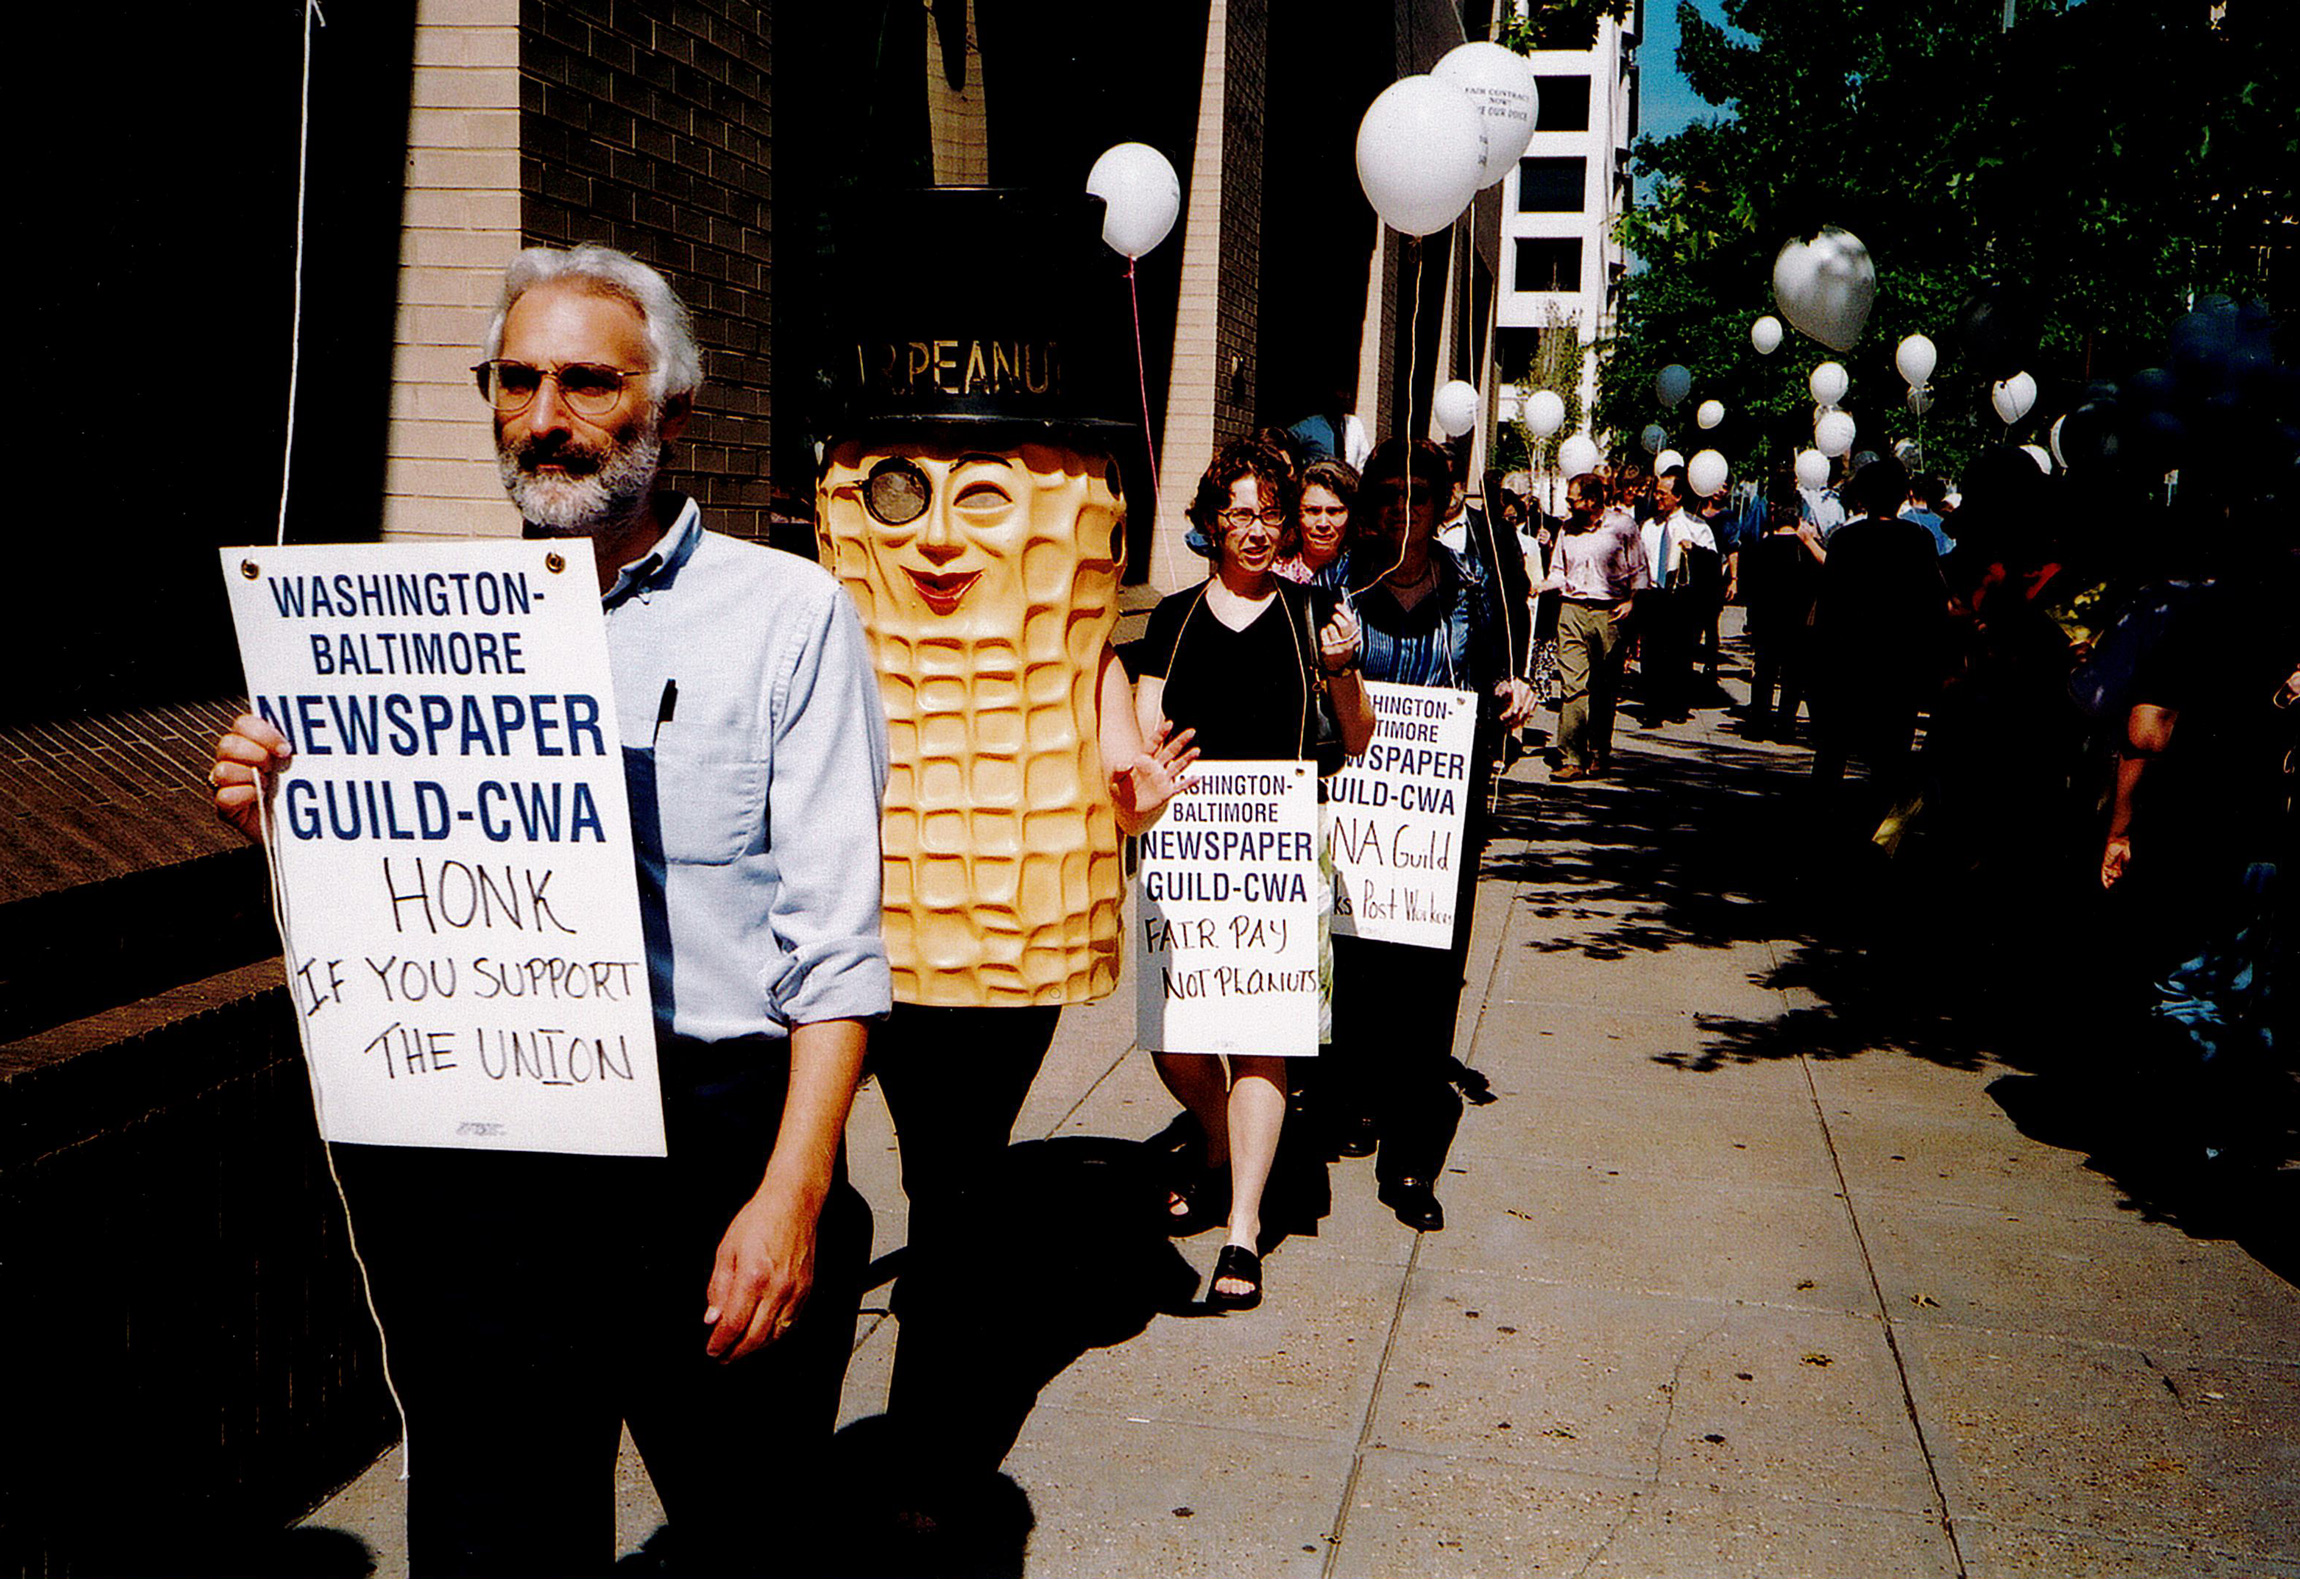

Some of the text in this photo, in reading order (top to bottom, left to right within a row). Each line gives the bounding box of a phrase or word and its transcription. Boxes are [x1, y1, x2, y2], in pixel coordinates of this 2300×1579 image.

[268, 571, 545, 618] WASHINGTON-
[310, 632, 527, 675] BALTIMORE
[257, 694, 607, 757] NEWSPAPER
[1373, 694, 1454, 720] HINGTON-
[1376, 719, 1440, 743] TIMORE
[1179, 774, 1293, 796] SHINGTON-
[1324, 776, 1454, 816] UILD-CWA
[285, 779, 607, 843] GUILD-CWA
[1173, 802, 1279, 824] BALTIMORE
[1140, 831, 1313, 862] NEWSPAPER
[1392, 823, 1451, 871] Guild
[383, 857, 577, 934] HONK
[1147, 871, 1308, 903] GUILD-CWA
[1362, 878, 1398, 920] Post
[1145, 915, 1287, 954] FAIR PAY
[297, 955, 640, 1017] IF YOU SUPPORT
[1161, 966, 1211, 999] NOT
[364, 1022, 634, 1086] THE UNION
